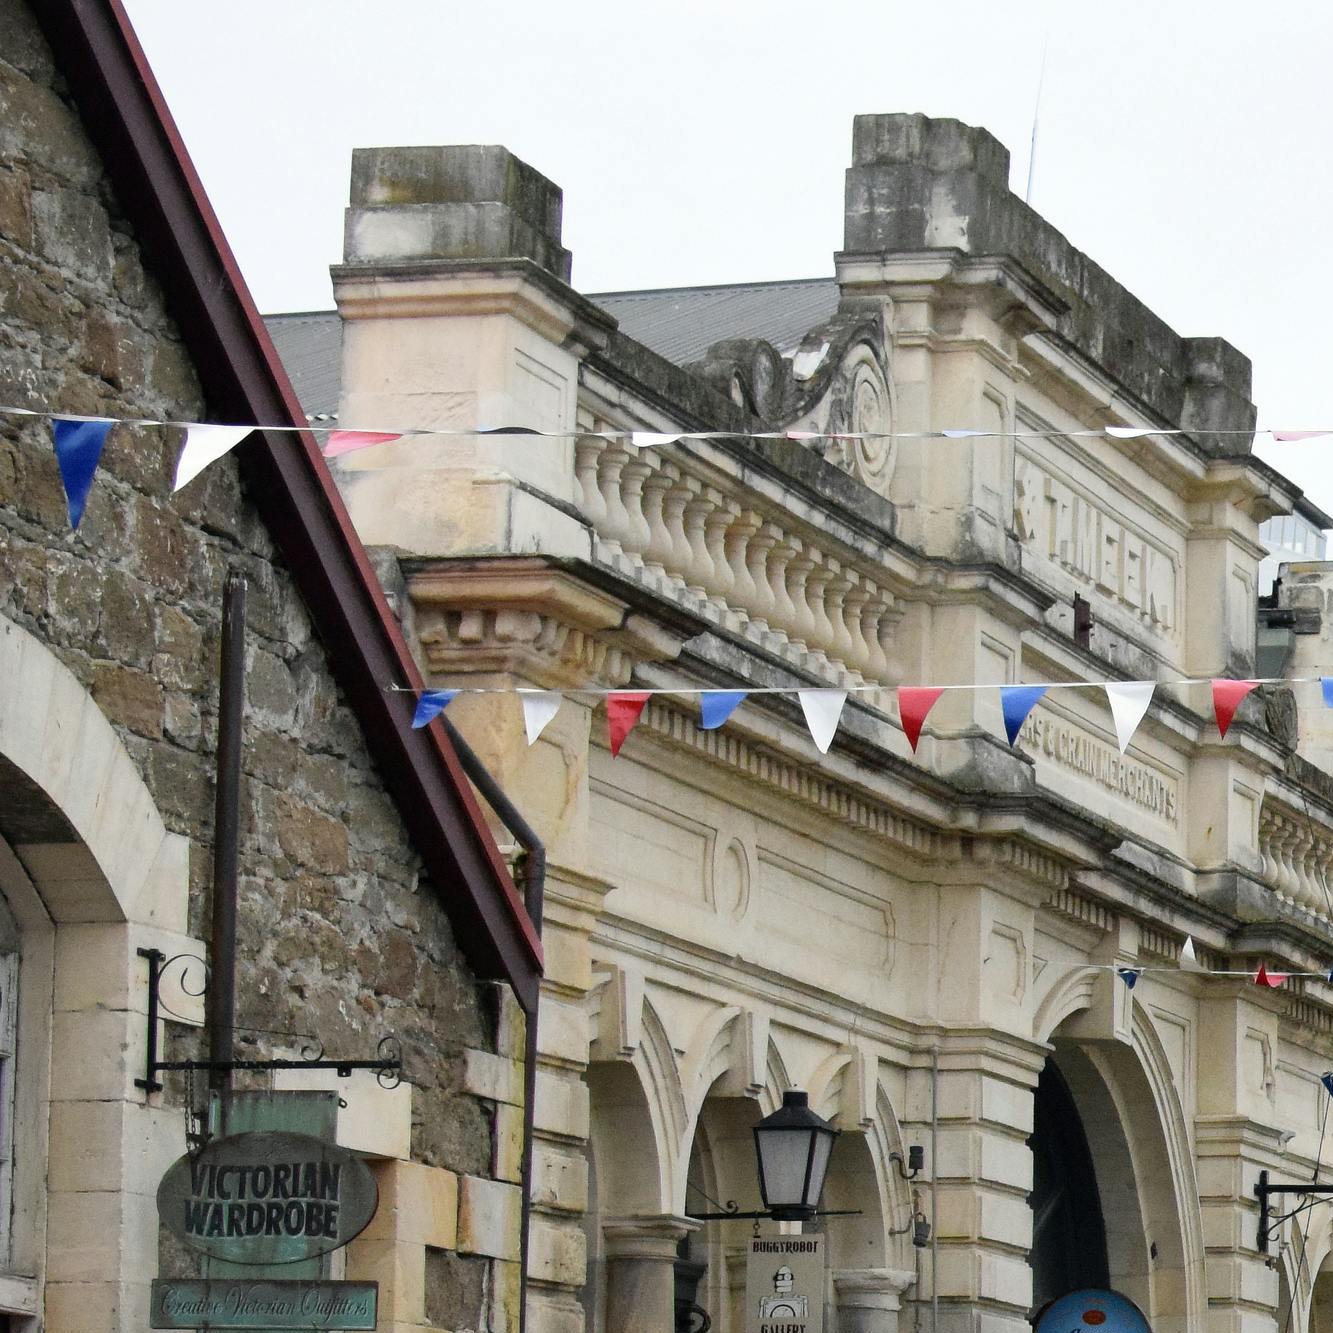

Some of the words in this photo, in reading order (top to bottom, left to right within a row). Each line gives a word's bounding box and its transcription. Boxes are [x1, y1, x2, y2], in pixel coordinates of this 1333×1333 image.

[188, 1161, 341, 1201] VICTORIAN
[184, 1199, 341, 1239] WARDROBE
[752, 1240, 819, 1254] BUGGYROBOT
[160, 1284, 224, 1318] Creative
[224, 1284, 297, 1319] Victorian
[299, 1284, 369, 1324] Outfitters
